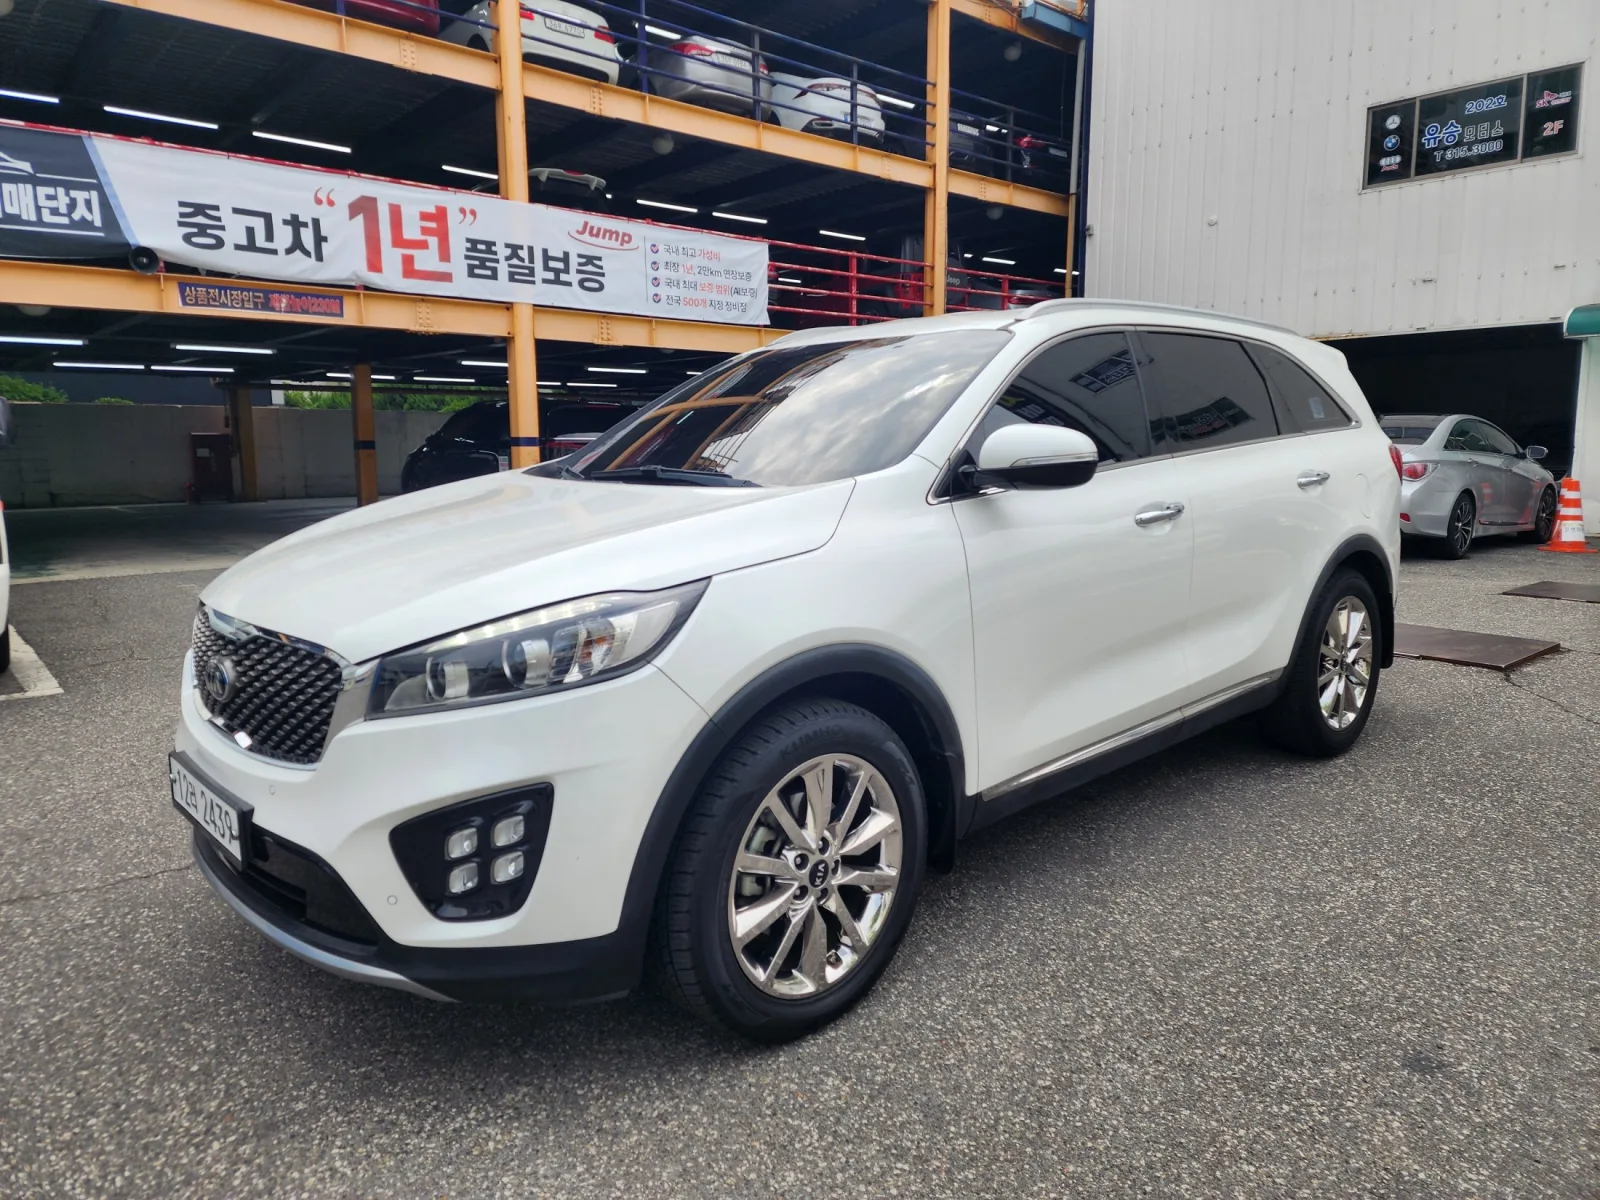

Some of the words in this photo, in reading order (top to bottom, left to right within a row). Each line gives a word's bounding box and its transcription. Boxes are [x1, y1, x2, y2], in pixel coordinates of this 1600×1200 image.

[1465, 95, 1507, 114] 202호
[1422, 120, 1462, 148] 유승
[1464, 120, 1504, 142] 모터스
[1543, 120, 1564, 136] 2F
[1434, 150, 1443, 162] T
[1445, 139, 1504, 160] 315.3000
[0, 183, 102, 227] 매단지
[576, 220, 634, 247] Jump
[177, 200, 329, 263] 중고차
[463, 237, 606, 293] 품질보증
[664, 243, 680, 257] 국내
[681, 246, 697, 258] 최고
[697, 248, 721, 262] 가성비
[664, 260, 680, 273] 최장
[682, 263, 696, 276] 1년,
[697, 265, 722, 277] 2만km
[723, 269, 752, 282] 연장보증
[665, 277, 681, 290] 국내
[682, 279, 698, 293] 최대
[699, 282, 713, 294] 보증
[184, 286, 265, 309] 상품전시장입구
[665, 294, 681, 307] 전국
[683, 297, 707, 309] 500개
[708, 299, 723, 311] 지정
[725, 301, 747, 313] 정비점
[201, 789, 235, 844] 2439
